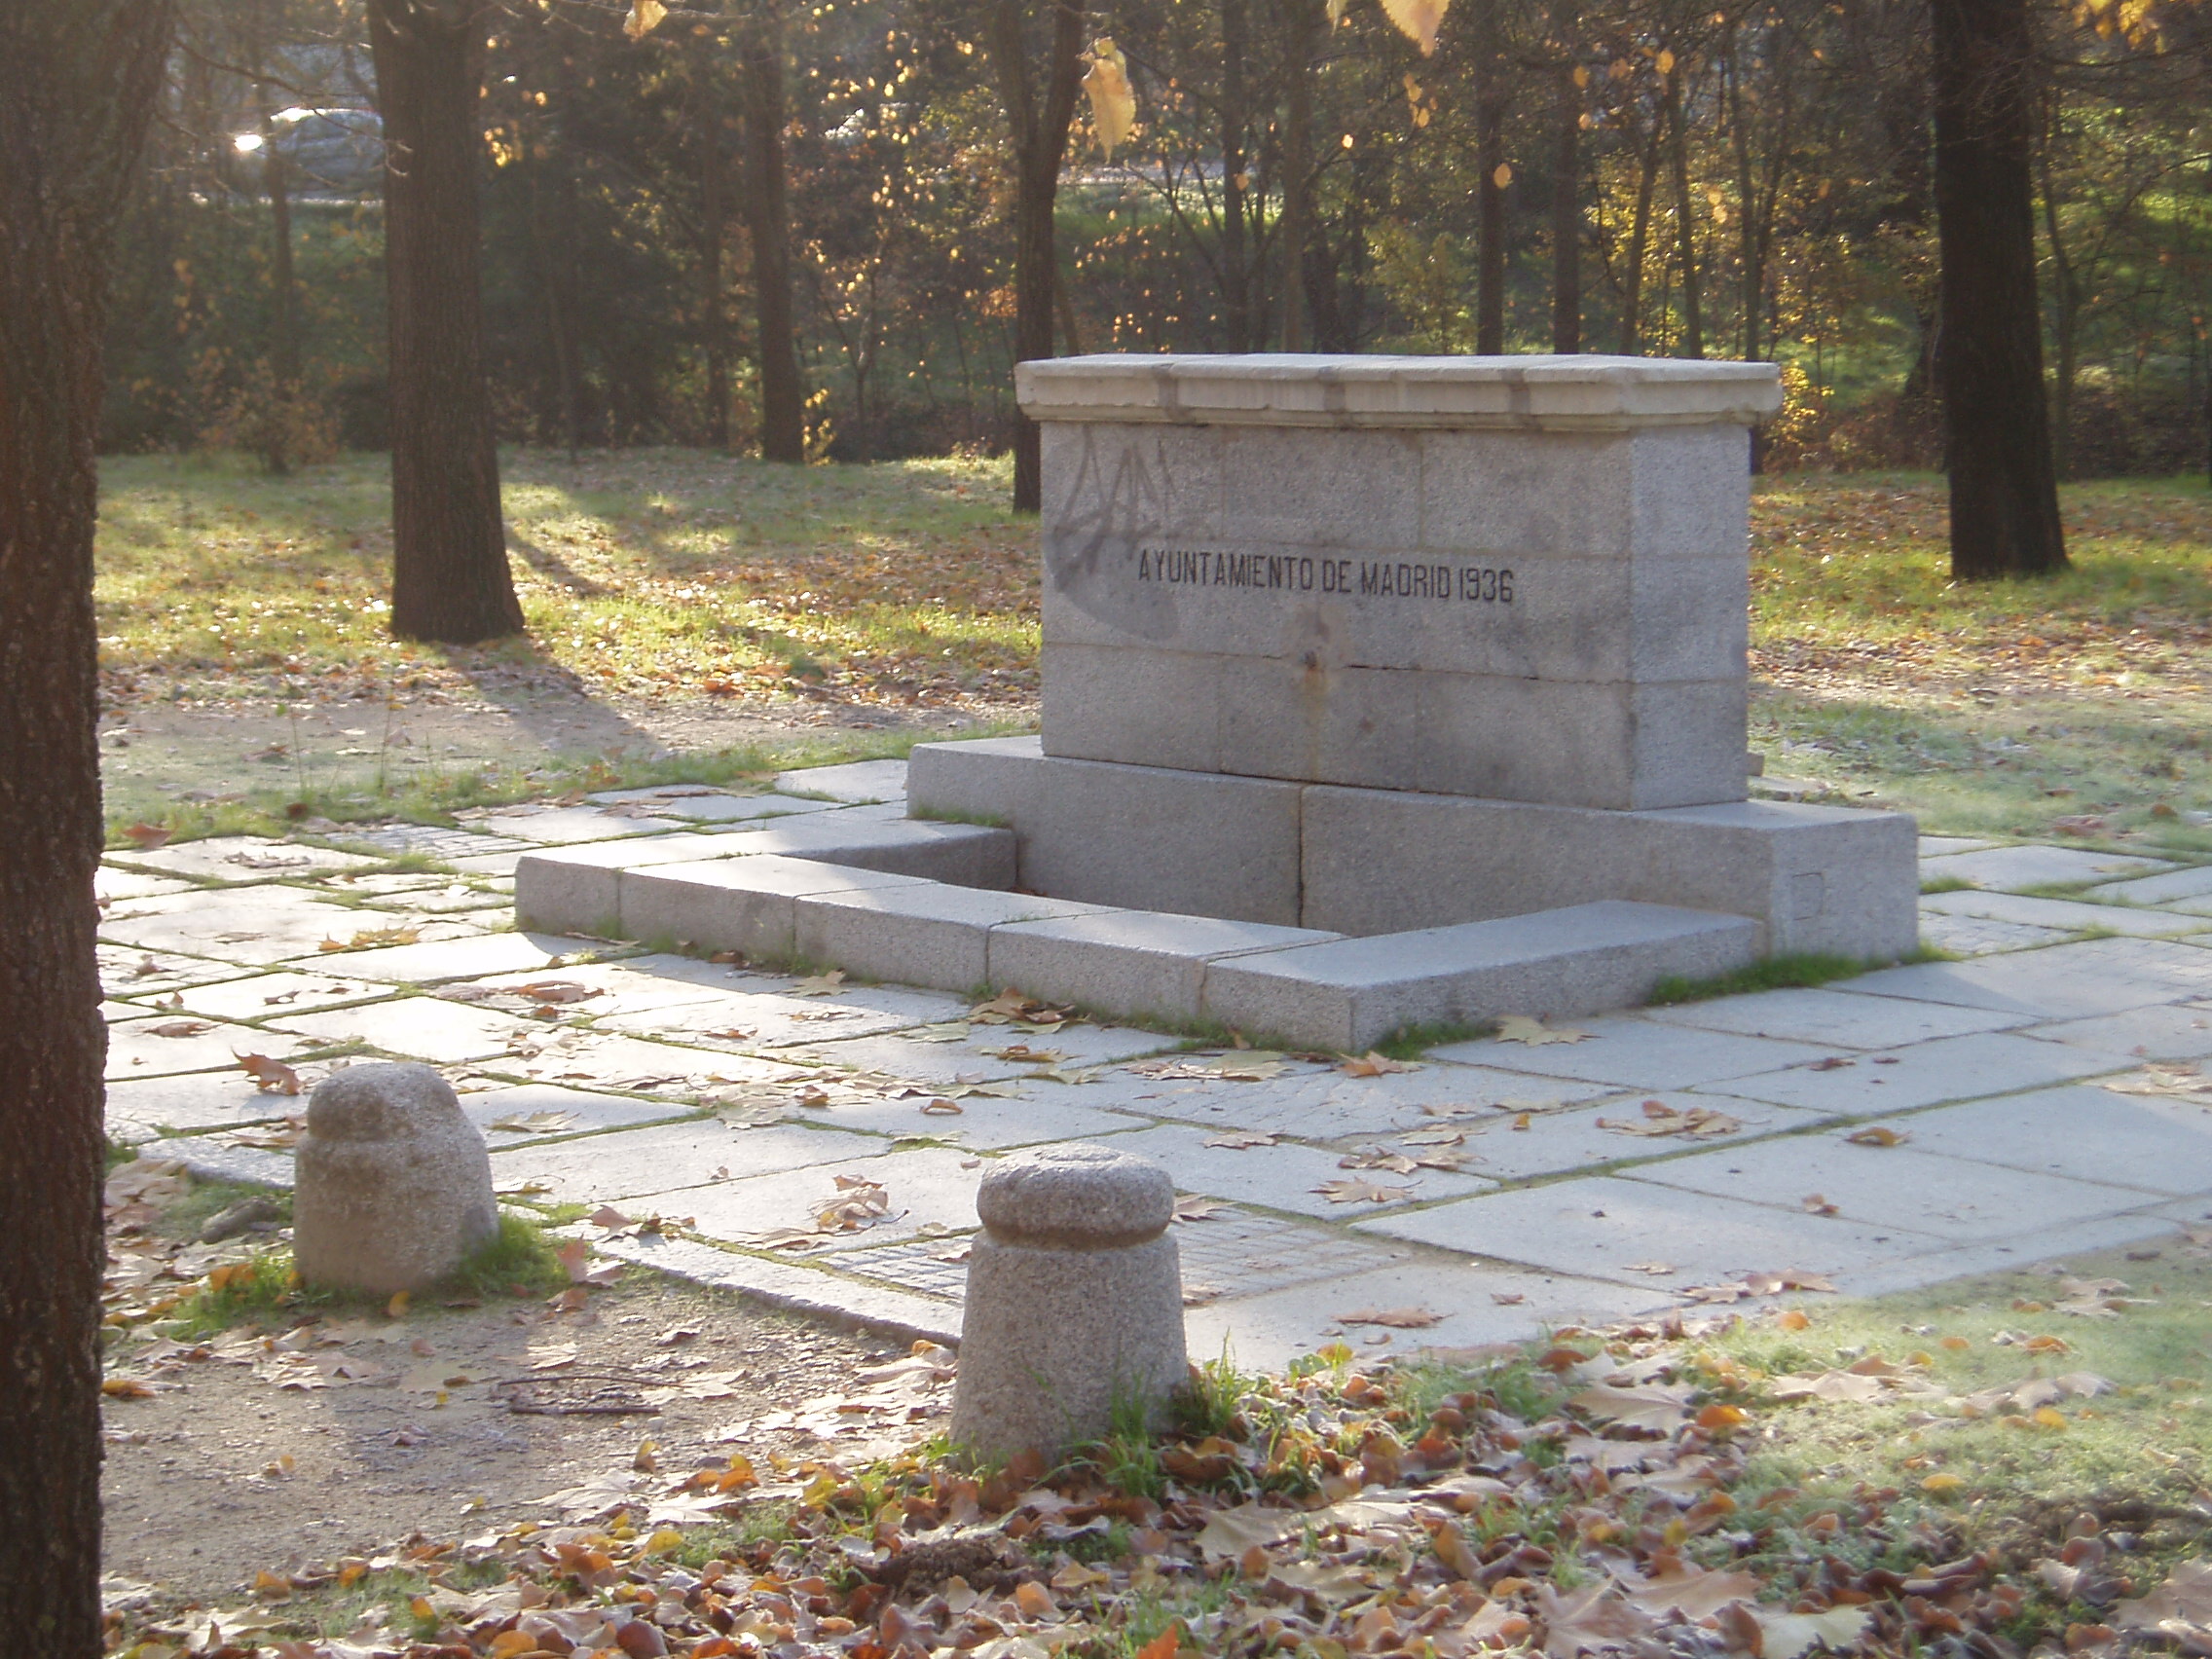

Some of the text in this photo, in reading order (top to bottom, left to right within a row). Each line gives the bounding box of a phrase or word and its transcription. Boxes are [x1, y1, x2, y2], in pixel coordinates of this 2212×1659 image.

[1138, 548, 1514, 603] AYUNTAMIENTO DE MADRID 1936
